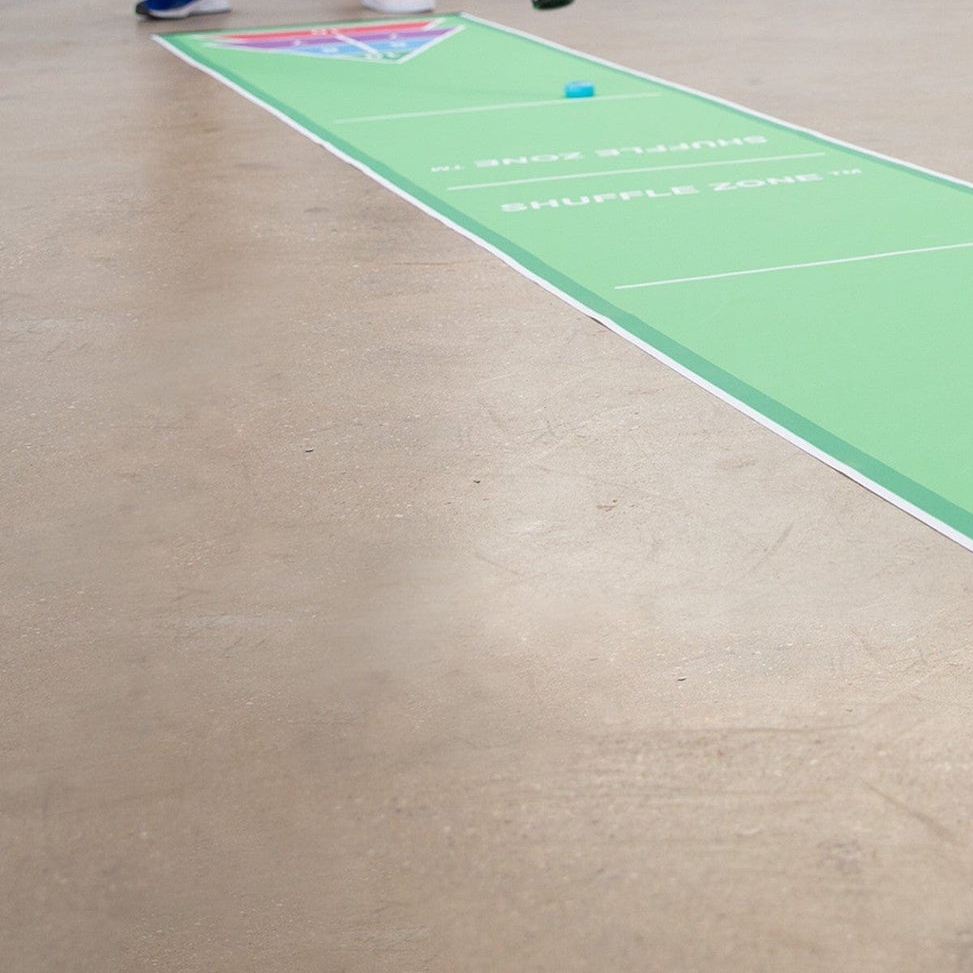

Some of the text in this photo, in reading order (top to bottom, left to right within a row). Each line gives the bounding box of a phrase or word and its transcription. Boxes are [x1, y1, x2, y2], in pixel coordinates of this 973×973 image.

[594, 135, 769, 157] SHUFFLE
[474, 151, 587, 168] ZONE
[500, 184, 700, 213] SHUFFLE
[712, 172, 824, 192] ZONE
